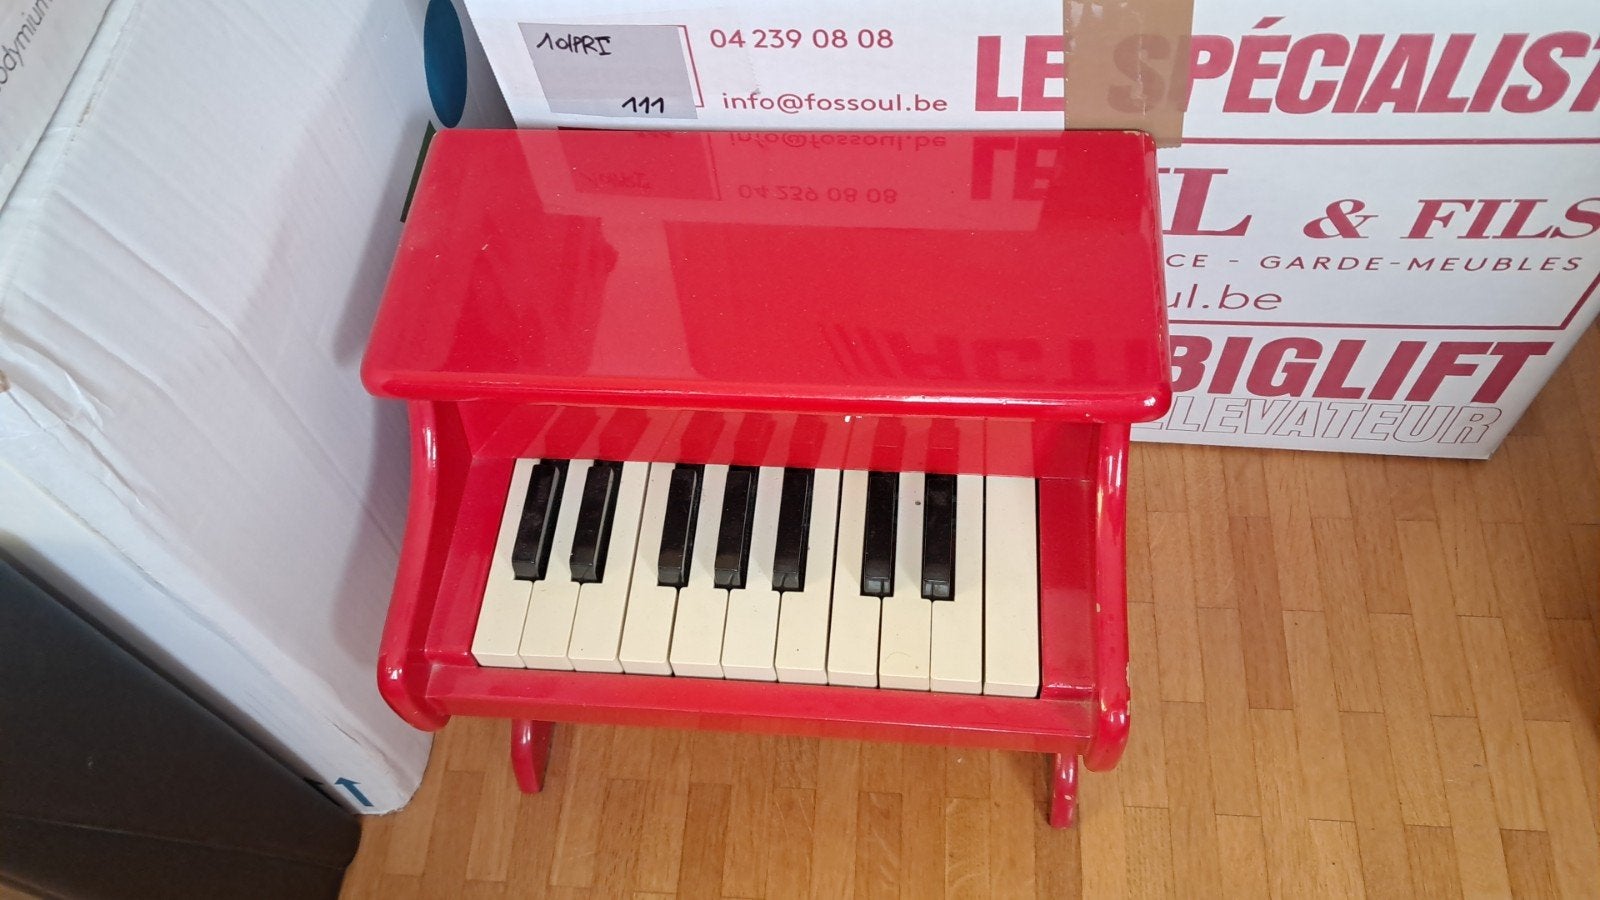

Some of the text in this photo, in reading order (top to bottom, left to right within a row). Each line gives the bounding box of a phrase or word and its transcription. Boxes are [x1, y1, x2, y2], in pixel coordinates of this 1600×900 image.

[710, 29, 894, 49] 04 239 08 08
[974, 35, 1064, 112] LE
[621, 96, 665, 114] 111
[722, 93, 948, 114] info@fossoul.be
[1304, 199, 1378, 239] &
[1401, 197, 1600, 240] FILS
[1260, 254, 1583, 272] GARDE-MEUBLES
[1169, 335, 1554, 403] BIGLIFT
[1131, 395, 1502, 444] LEVATEUR
